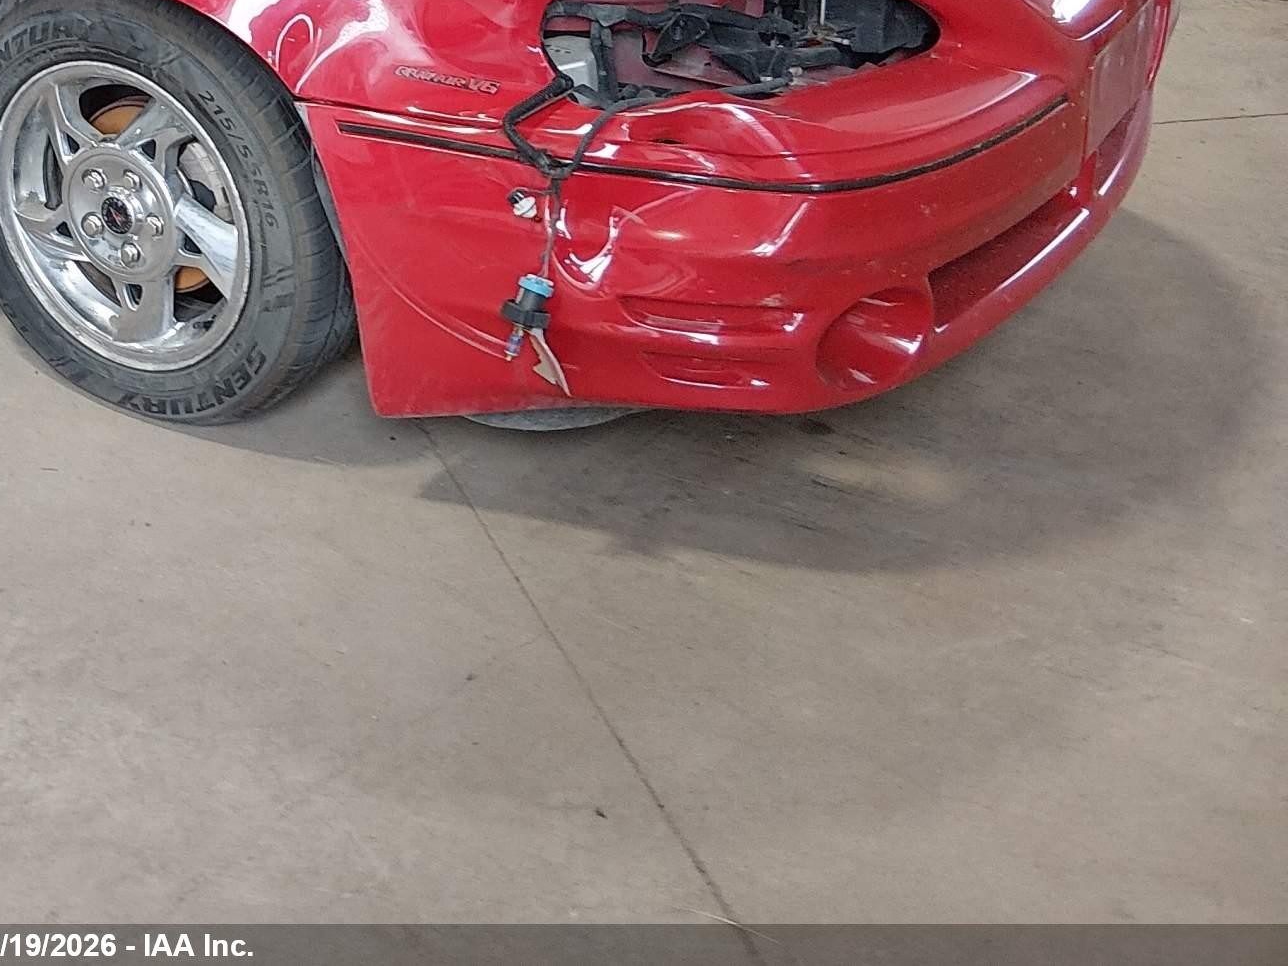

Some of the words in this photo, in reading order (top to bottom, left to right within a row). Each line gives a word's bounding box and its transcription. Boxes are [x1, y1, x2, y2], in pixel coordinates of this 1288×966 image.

[467, 77, 501, 95] V6
[198, 90, 279, 230] 215/55R16
[117, 341, 267, 416] SENTURY
